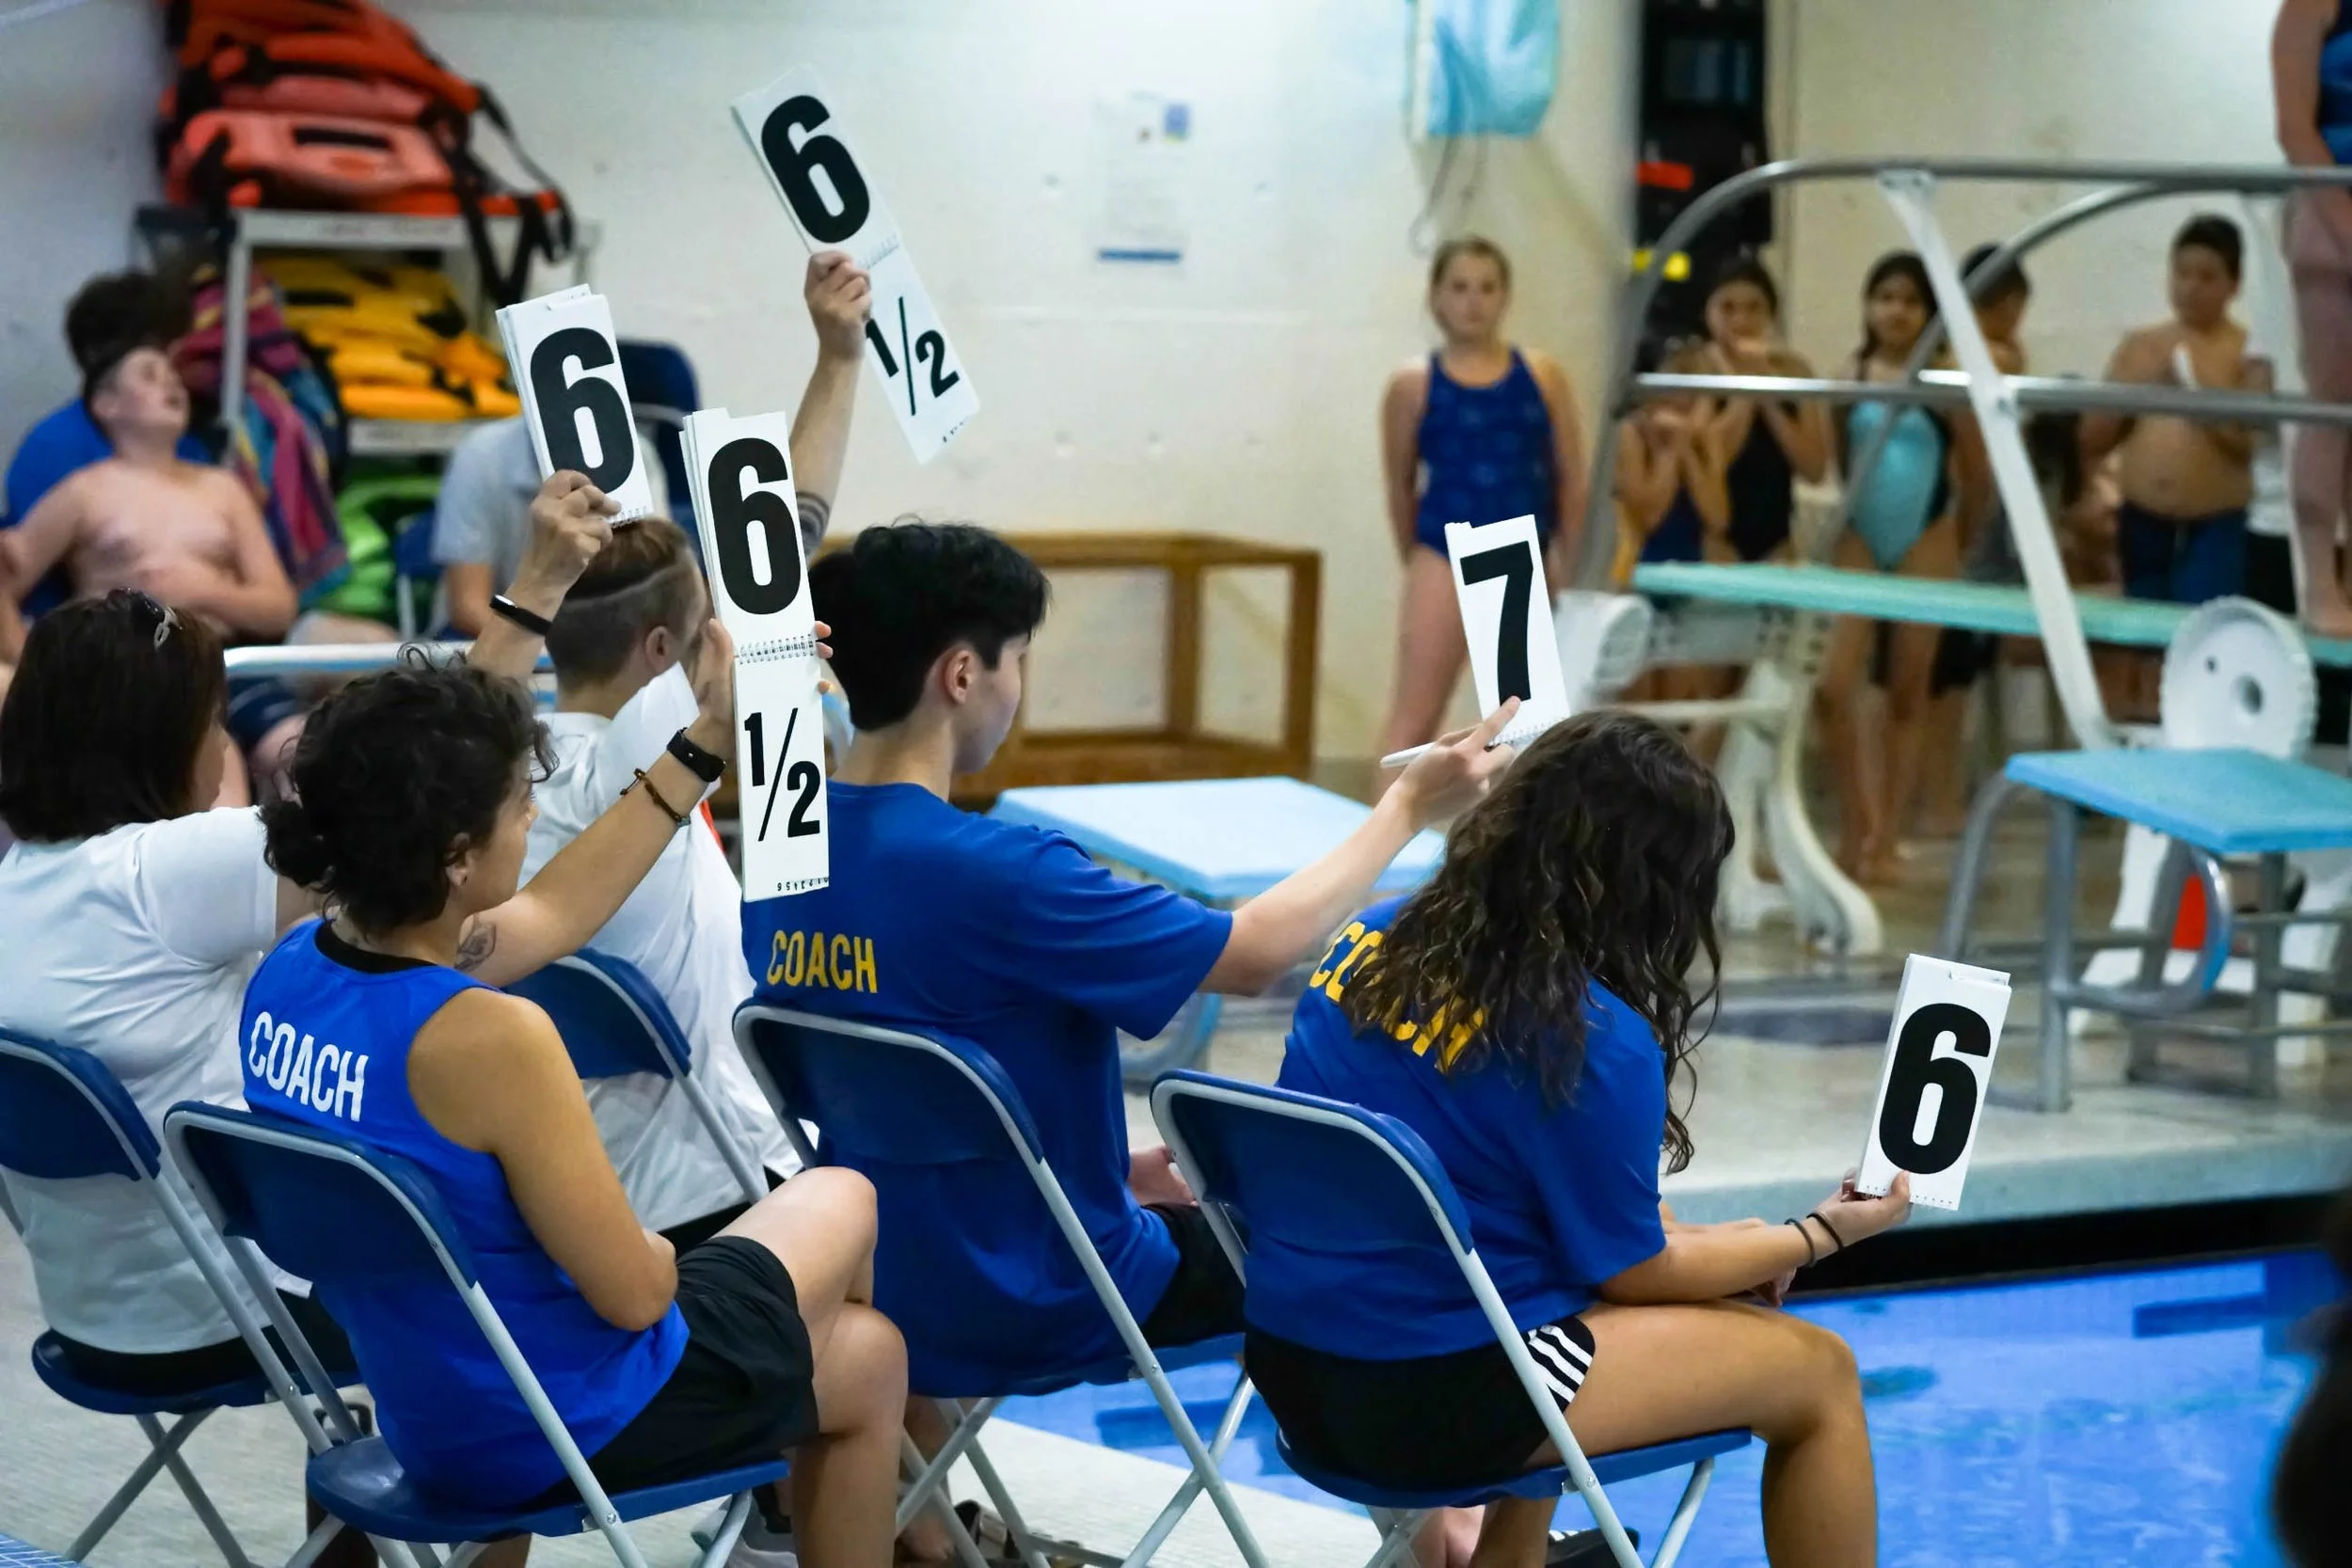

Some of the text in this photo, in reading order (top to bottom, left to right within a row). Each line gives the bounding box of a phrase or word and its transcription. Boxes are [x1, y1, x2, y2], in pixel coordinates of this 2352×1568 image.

[761, 95, 870, 244] 6
[530, 327, 634, 494] 6
[865, 296, 961, 416] 1/2
[707, 437, 802, 615] 6
[1459, 540, 1534, 707] 7
[743, 707, 821, 842] 1/2
[767, 929, 878, 993] COACH
[248, 1011, 370, 1122] COACH
[1879, 1003, 1992, 1175] 6
